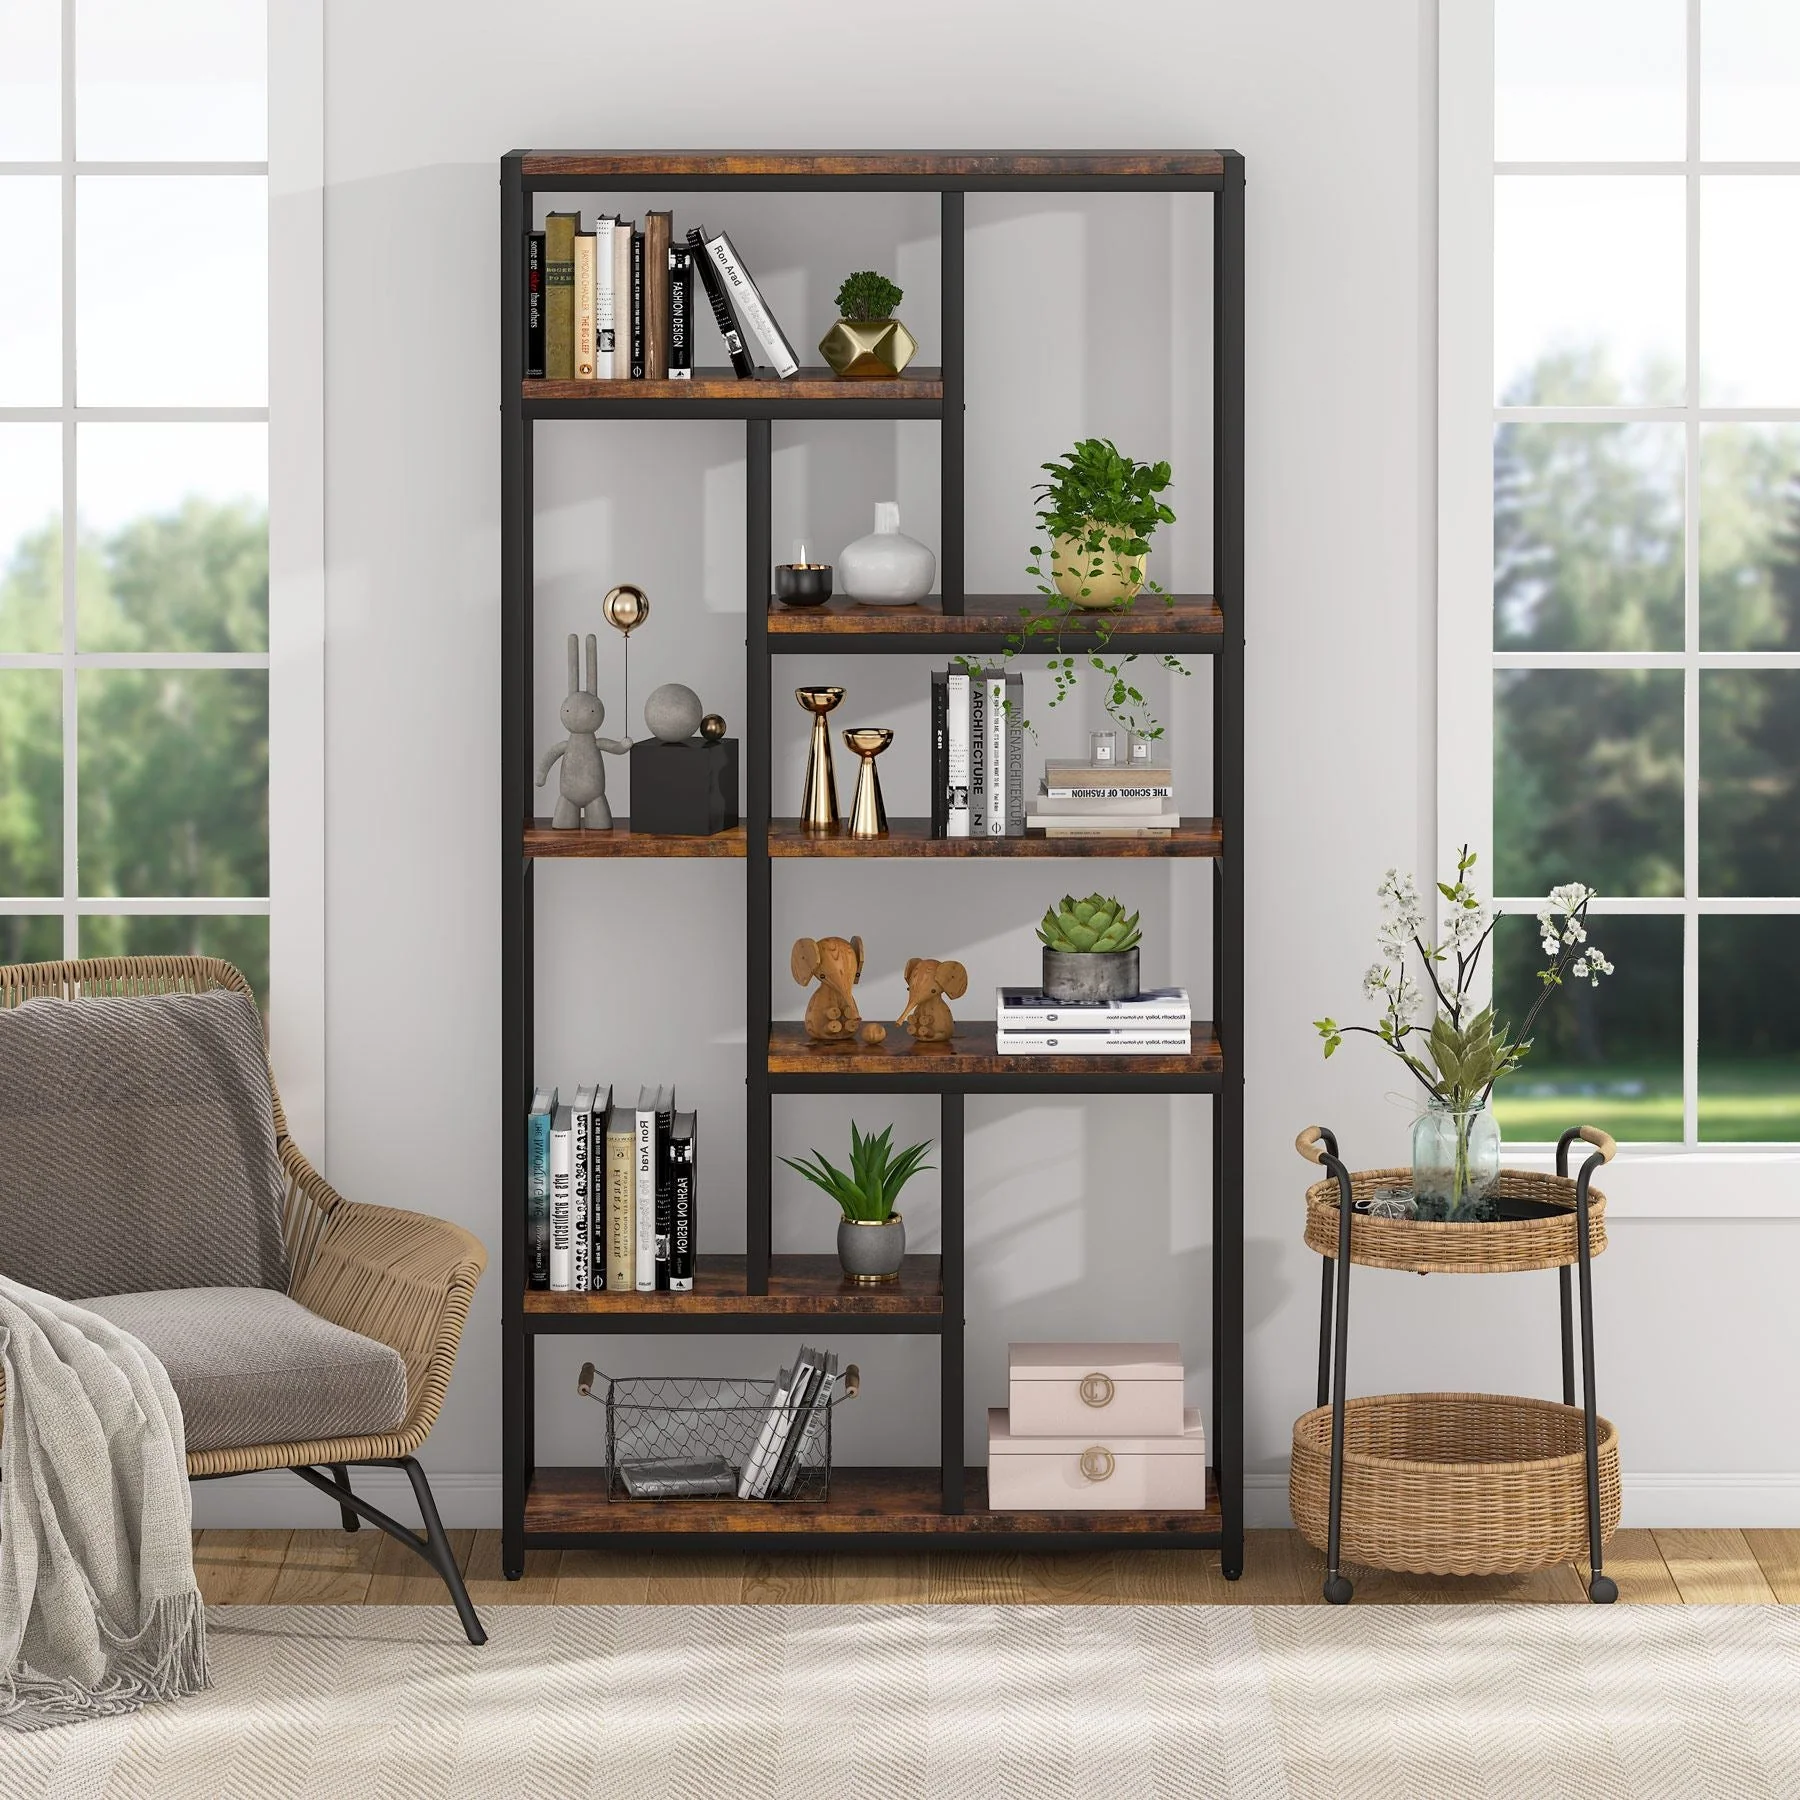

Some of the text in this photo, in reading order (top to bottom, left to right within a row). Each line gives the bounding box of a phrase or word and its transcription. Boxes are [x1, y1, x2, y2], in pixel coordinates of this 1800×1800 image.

[714, 244, 728, 266] Ron
[724, 262, 743, 287] Arad
[530, 292, 539, 306] than
[530, 308, 539, 328] others
[673, 282, 683, 347] FASHION DESIGN
[973, 691, 983, 795] ARCHITECTURE
[1010, 708, 1022, 826] INNENARCHITEKTUR
[1072, 789, 1105, 798] FASHION
[1107, 789, 1117, 797] OF
[1121, 789, 1151, 797] SCHOOL
[1152, 788, 1168, 796] THE
